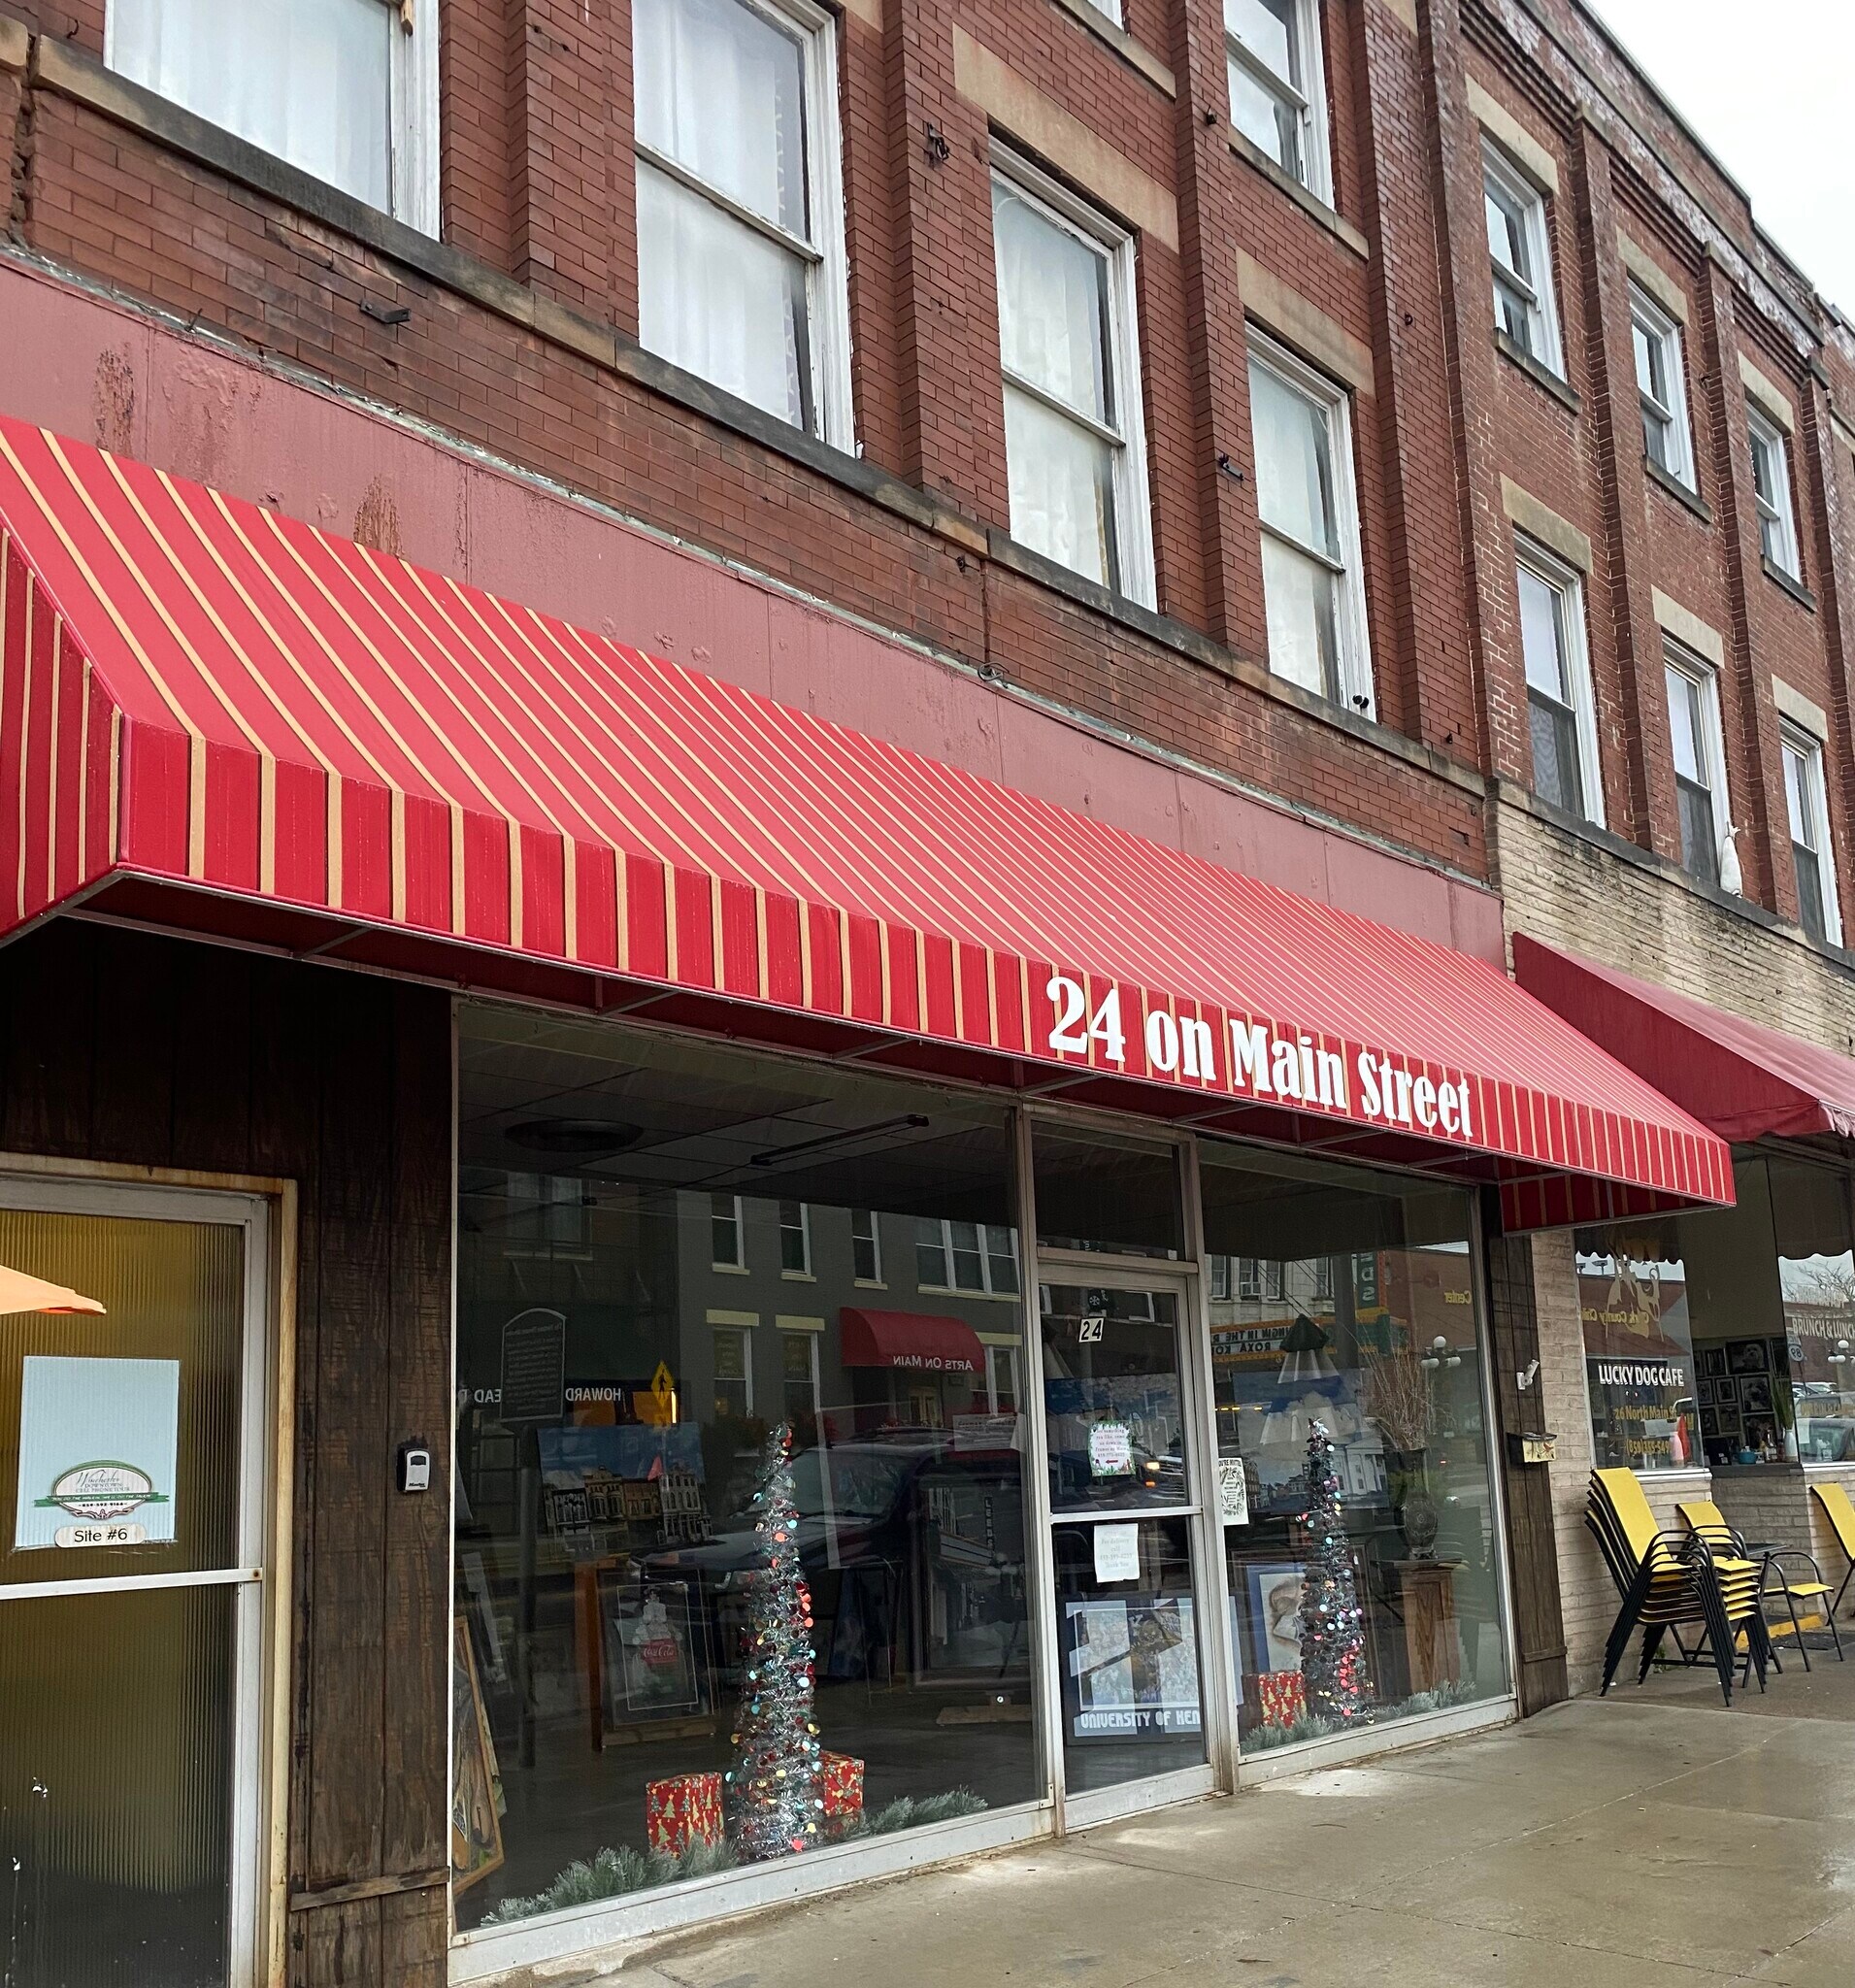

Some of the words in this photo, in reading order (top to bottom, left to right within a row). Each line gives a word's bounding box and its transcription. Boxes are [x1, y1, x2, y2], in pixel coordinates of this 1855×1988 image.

[1046, 976, 1126, 1063] 24
[1145, 1010, 1217, 1081] on
[1229, 1017, 1347, 1110] Main
[1358, 1051, 1474, 1138] Street
[1080, 1320, 1102, 1341] 24
[1792, 1317, 1825, 1338] BRUNCH
[1826, 1320, 1833, 1339] &
[1598, 1364, 1634, 1386] LUCKY
[1635, 1365, 1658, 1386] DOG
[1658, 1367, 1685, 1387] CAFE
[1613, 1407, 1624, 1420] 26
[1625, 1405, 1649, 1420] North
[1650, 1405, 1669, 1419] Main
[74, 1529, 102, 1542] Site
[107, 1528, 128, 1541] #6
[1080, 1711, 1150, 1729] UNIVERSITY
[1155, 1710, 1172, 1726] OF
[1176, 1709, 1201, 1725] KEN
